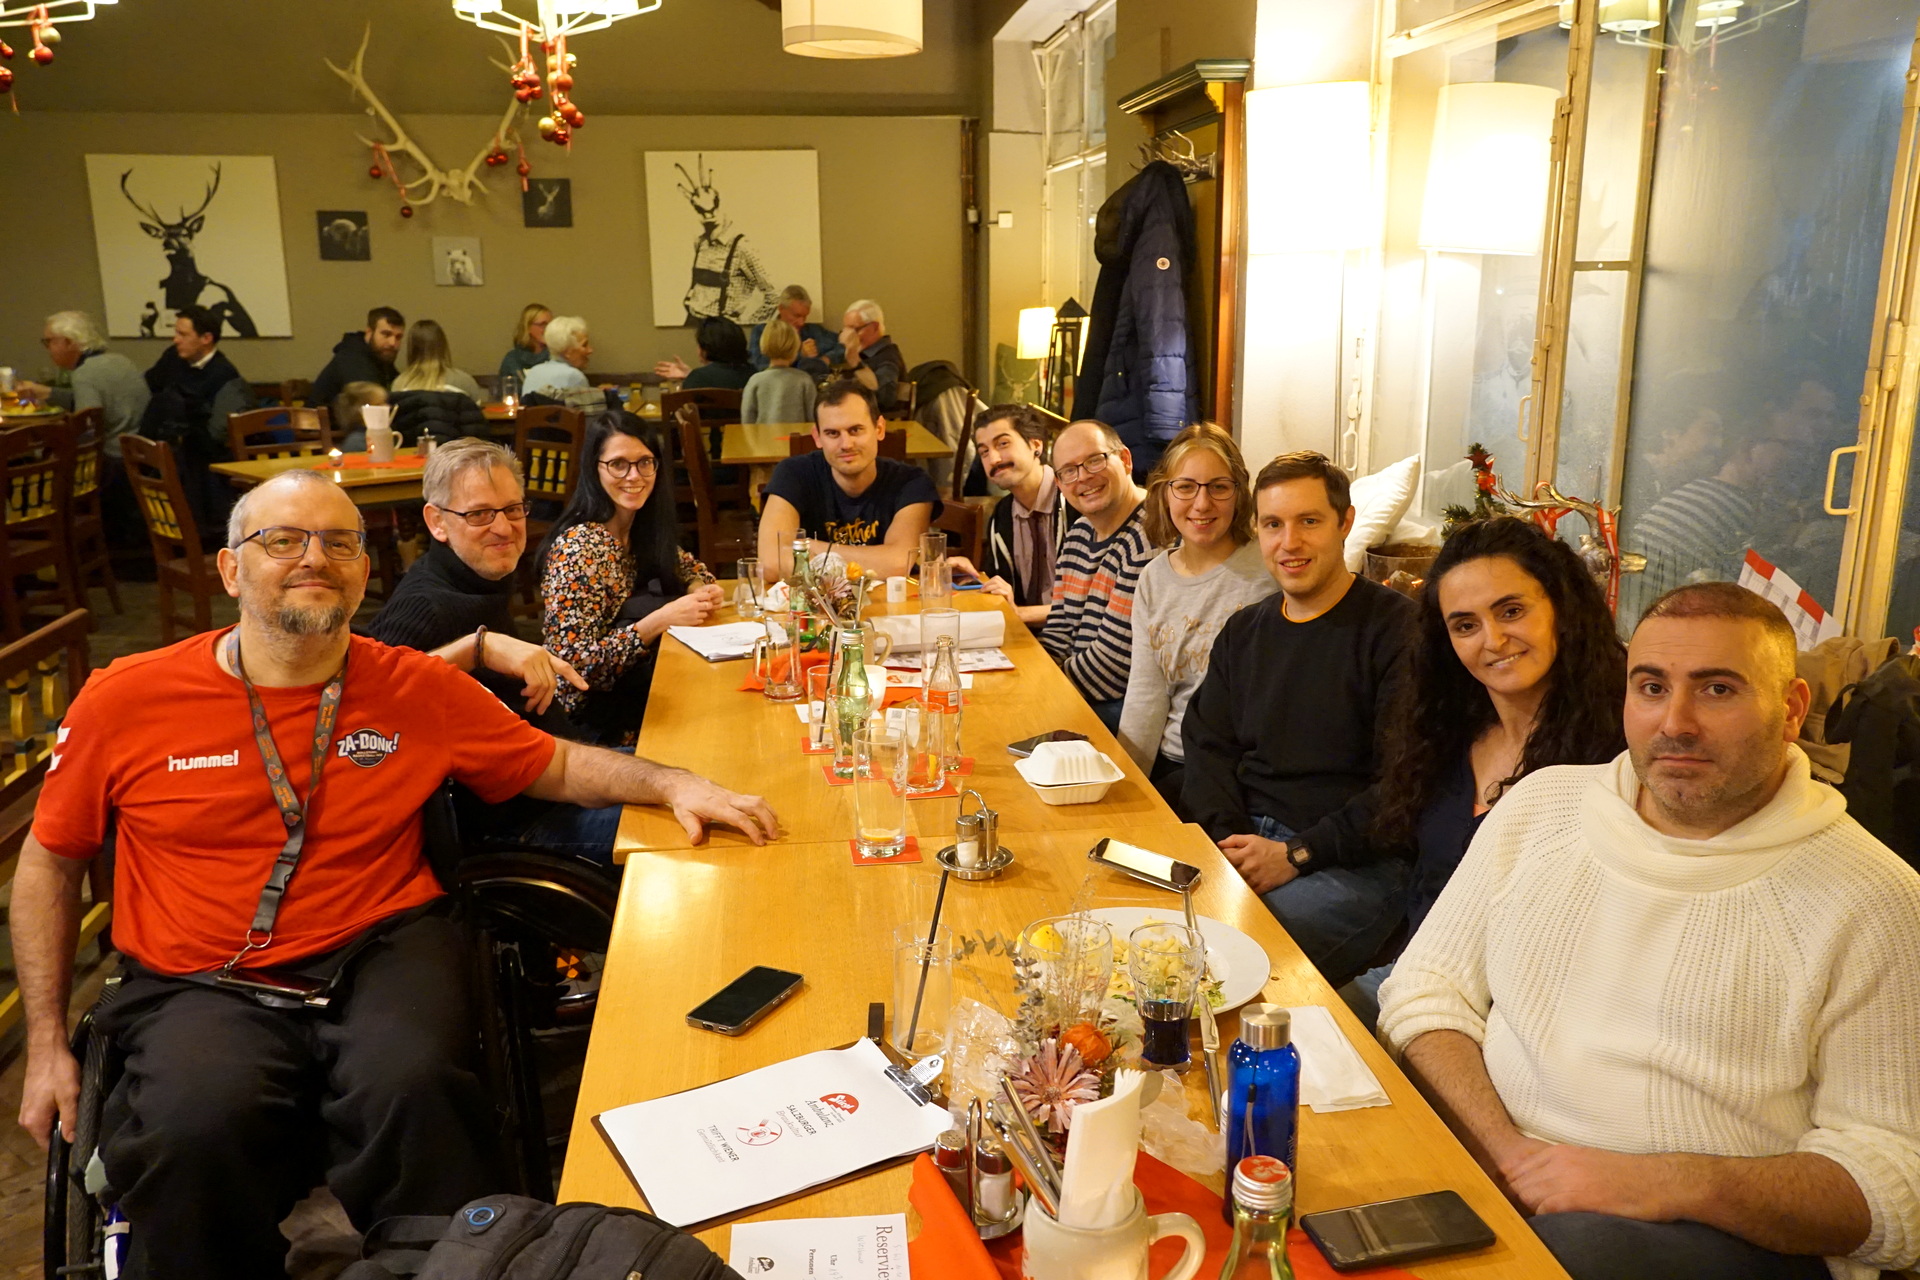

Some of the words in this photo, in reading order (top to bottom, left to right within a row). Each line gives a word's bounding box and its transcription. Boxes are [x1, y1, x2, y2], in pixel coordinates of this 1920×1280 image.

[337, 732, 400, 758] ZA-DONK!
[168, 749, 239, 772] hummel
[786, 1104, 817, 1135] SALZBURGER
[708, 1125, 726, 1142] TRIFFT
[720, 1142, 740, 1162] WIENER
[808, 1248, 816, 1275] Personen
[876, 1225, 893, 1280] Reservie
